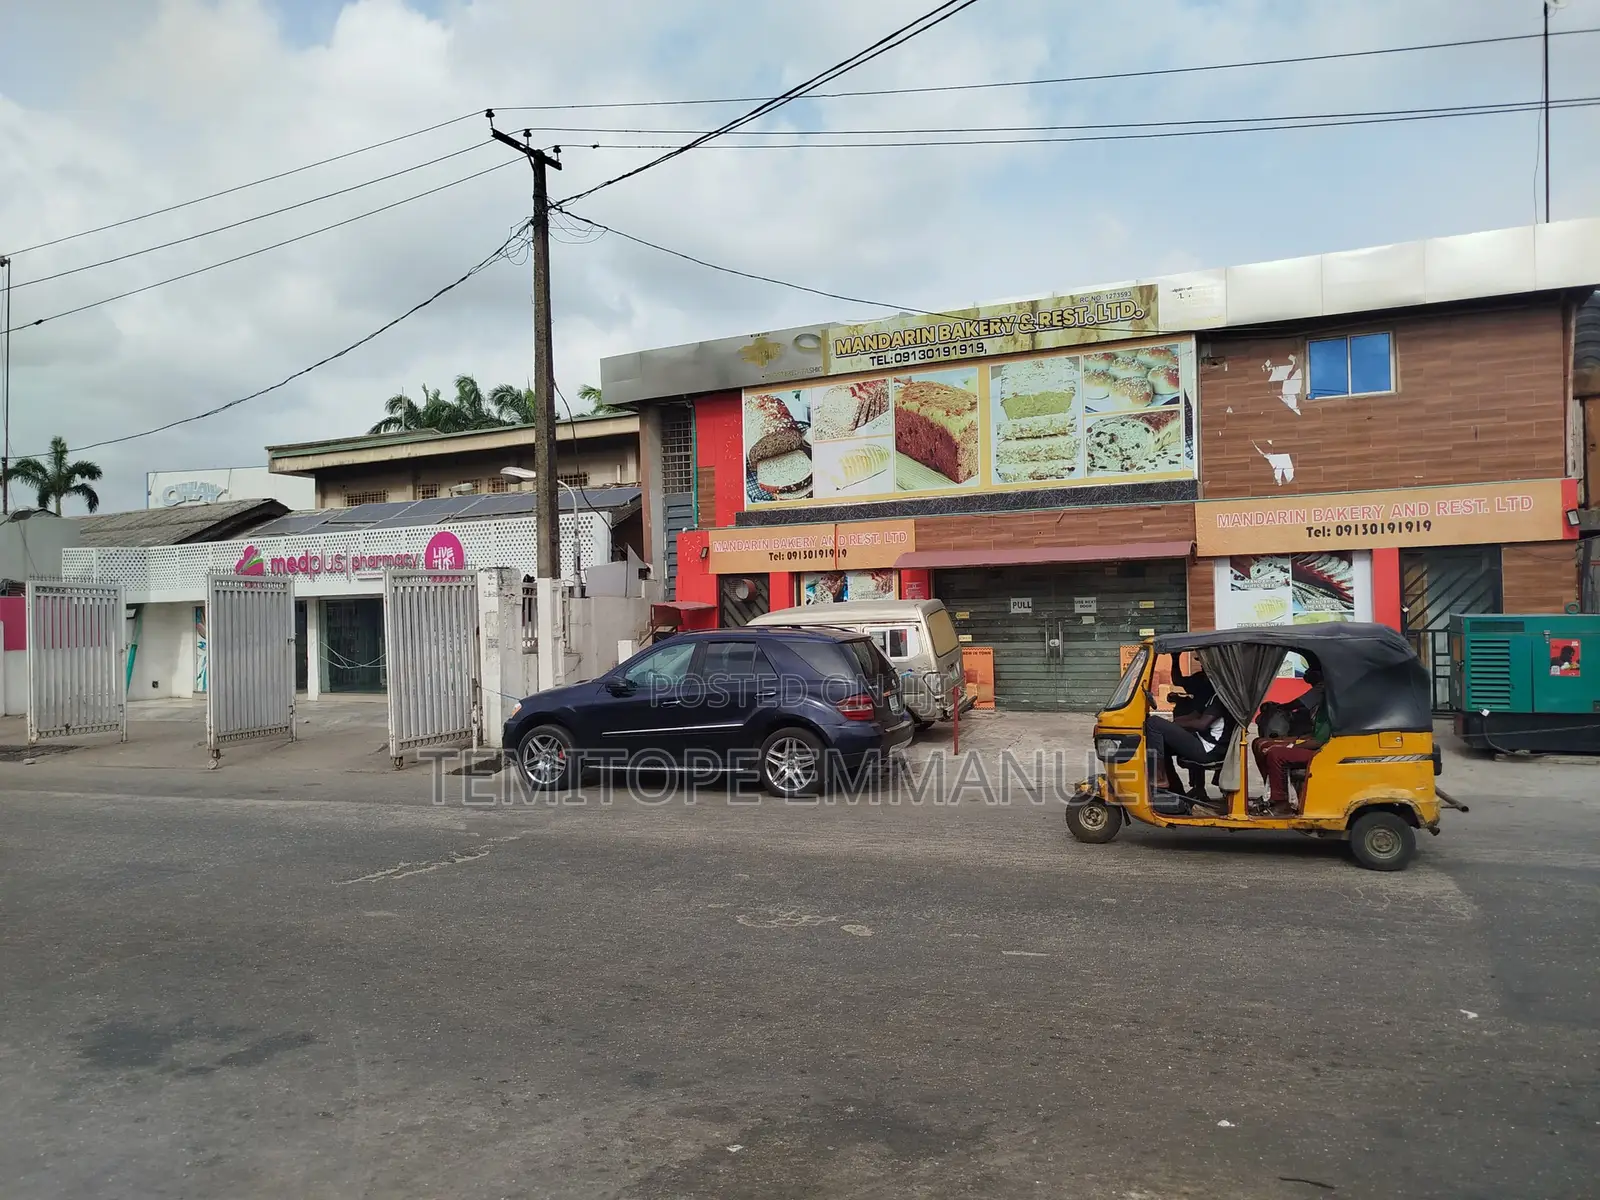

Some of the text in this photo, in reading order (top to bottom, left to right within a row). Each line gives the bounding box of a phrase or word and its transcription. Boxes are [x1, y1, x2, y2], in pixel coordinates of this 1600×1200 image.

[1105, 290, 1132, 299] 1273593
[834, 299, 1145, 357] MANDARIN BAKERY & REST. LTD.
[1216, 494, 1535, 529] MANDARIN BAKERY AND REST. LTD
[1305, 519, 1432, 538] Tel: 09130191919
[712, 538, 770, 553] MANDARIN
[773, 534, 818, 550] BAKERY
[849, 532, 882, 545] REST.
[884, 530, 908, 544] LTD
[270, 548, 419, 580] medplus pharmacy
[768, 552, 785, 562] Tel:
[1012, 601, 1032, 610] PULL
